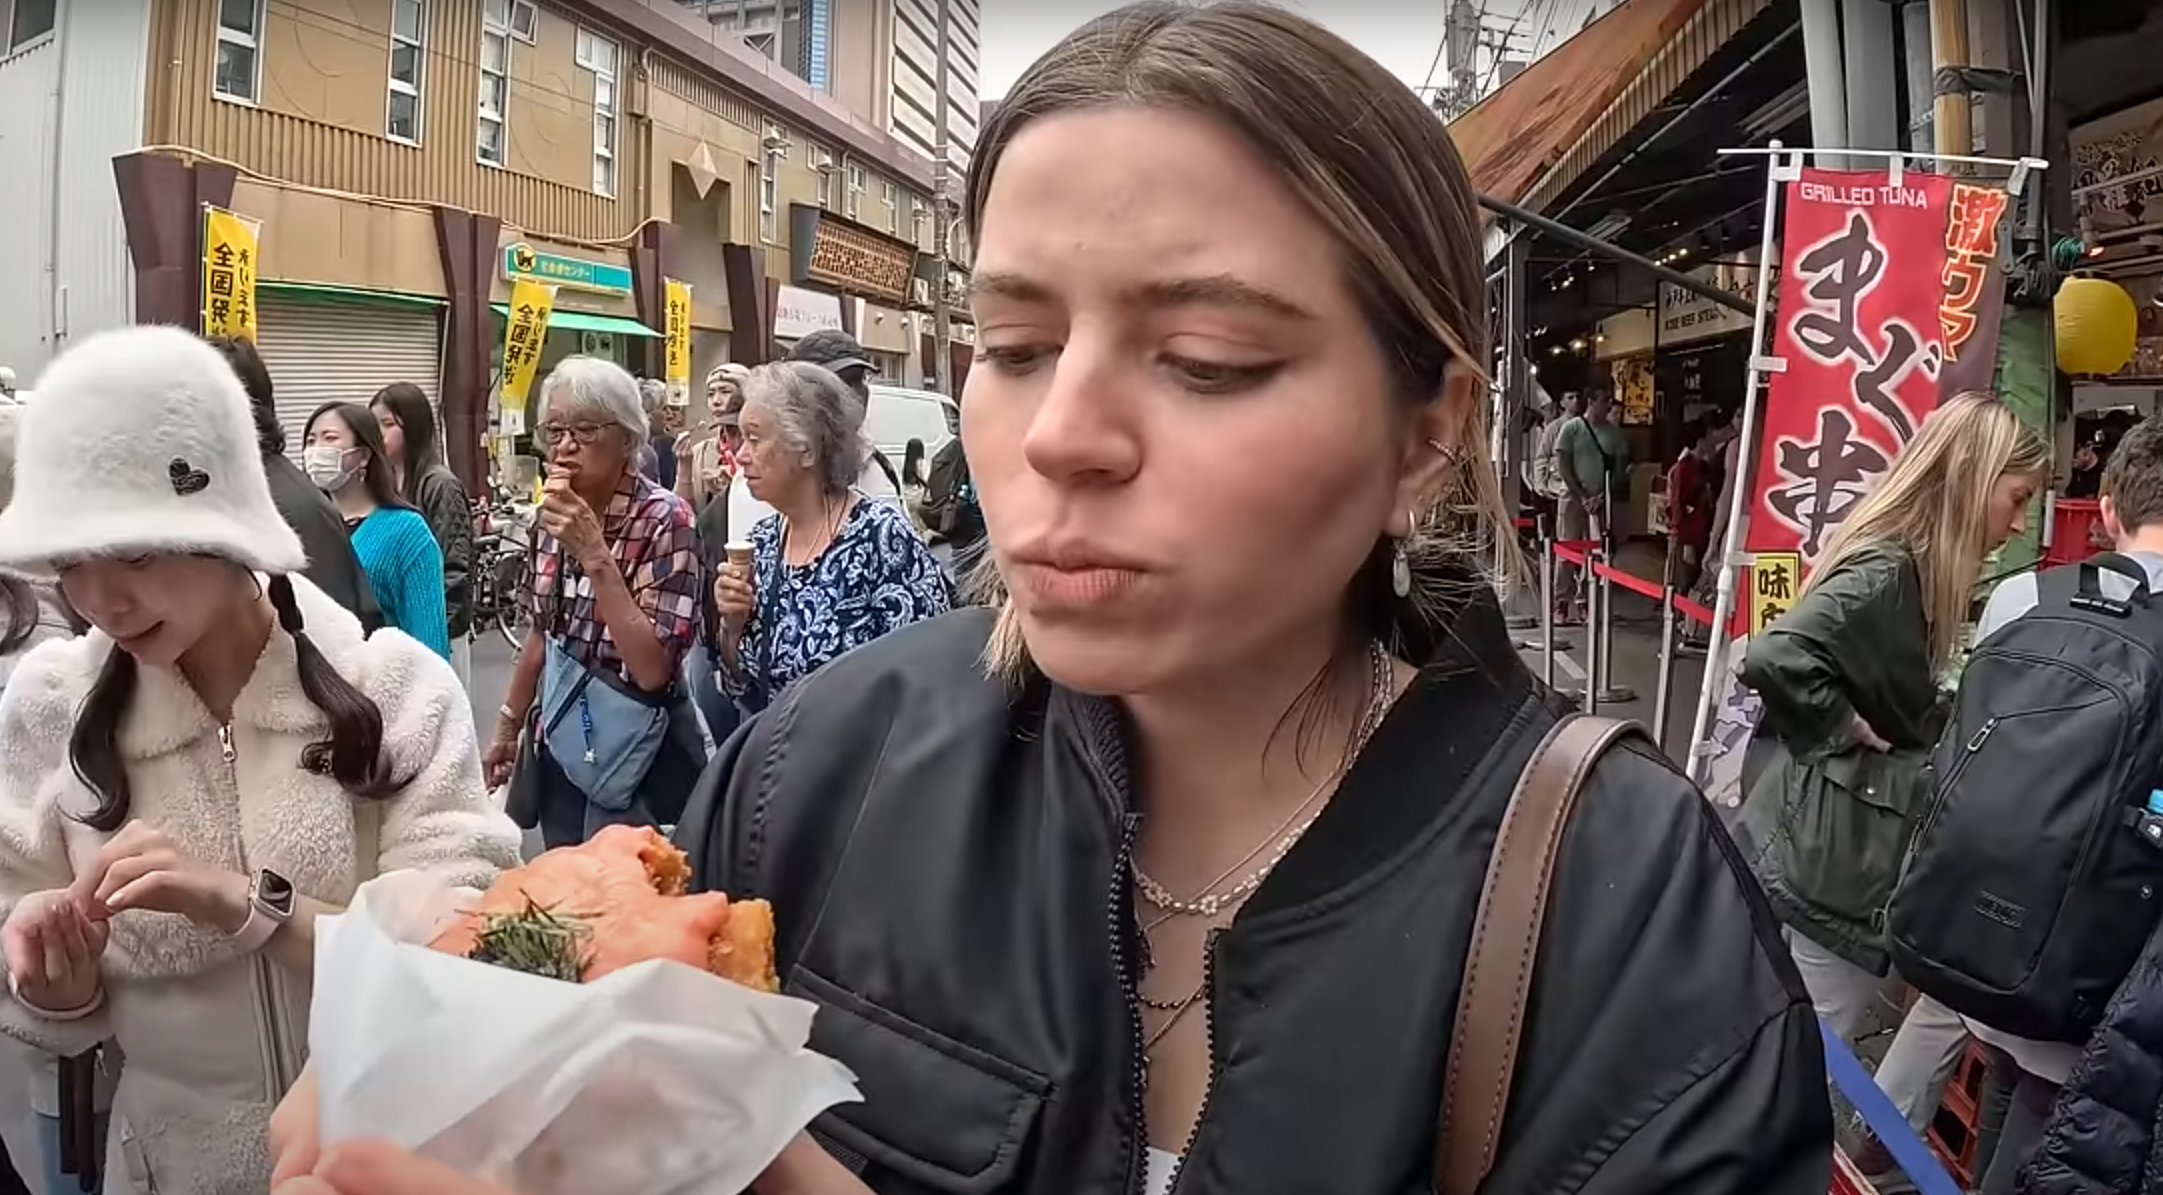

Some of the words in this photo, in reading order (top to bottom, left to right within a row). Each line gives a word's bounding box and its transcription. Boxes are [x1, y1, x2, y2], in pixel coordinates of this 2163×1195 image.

[1801, 183, 1874, 206] GRILLED
[1879, 186, 1927, 209] TUNA
[1939, 184, 2009, 362] 激ウマ
